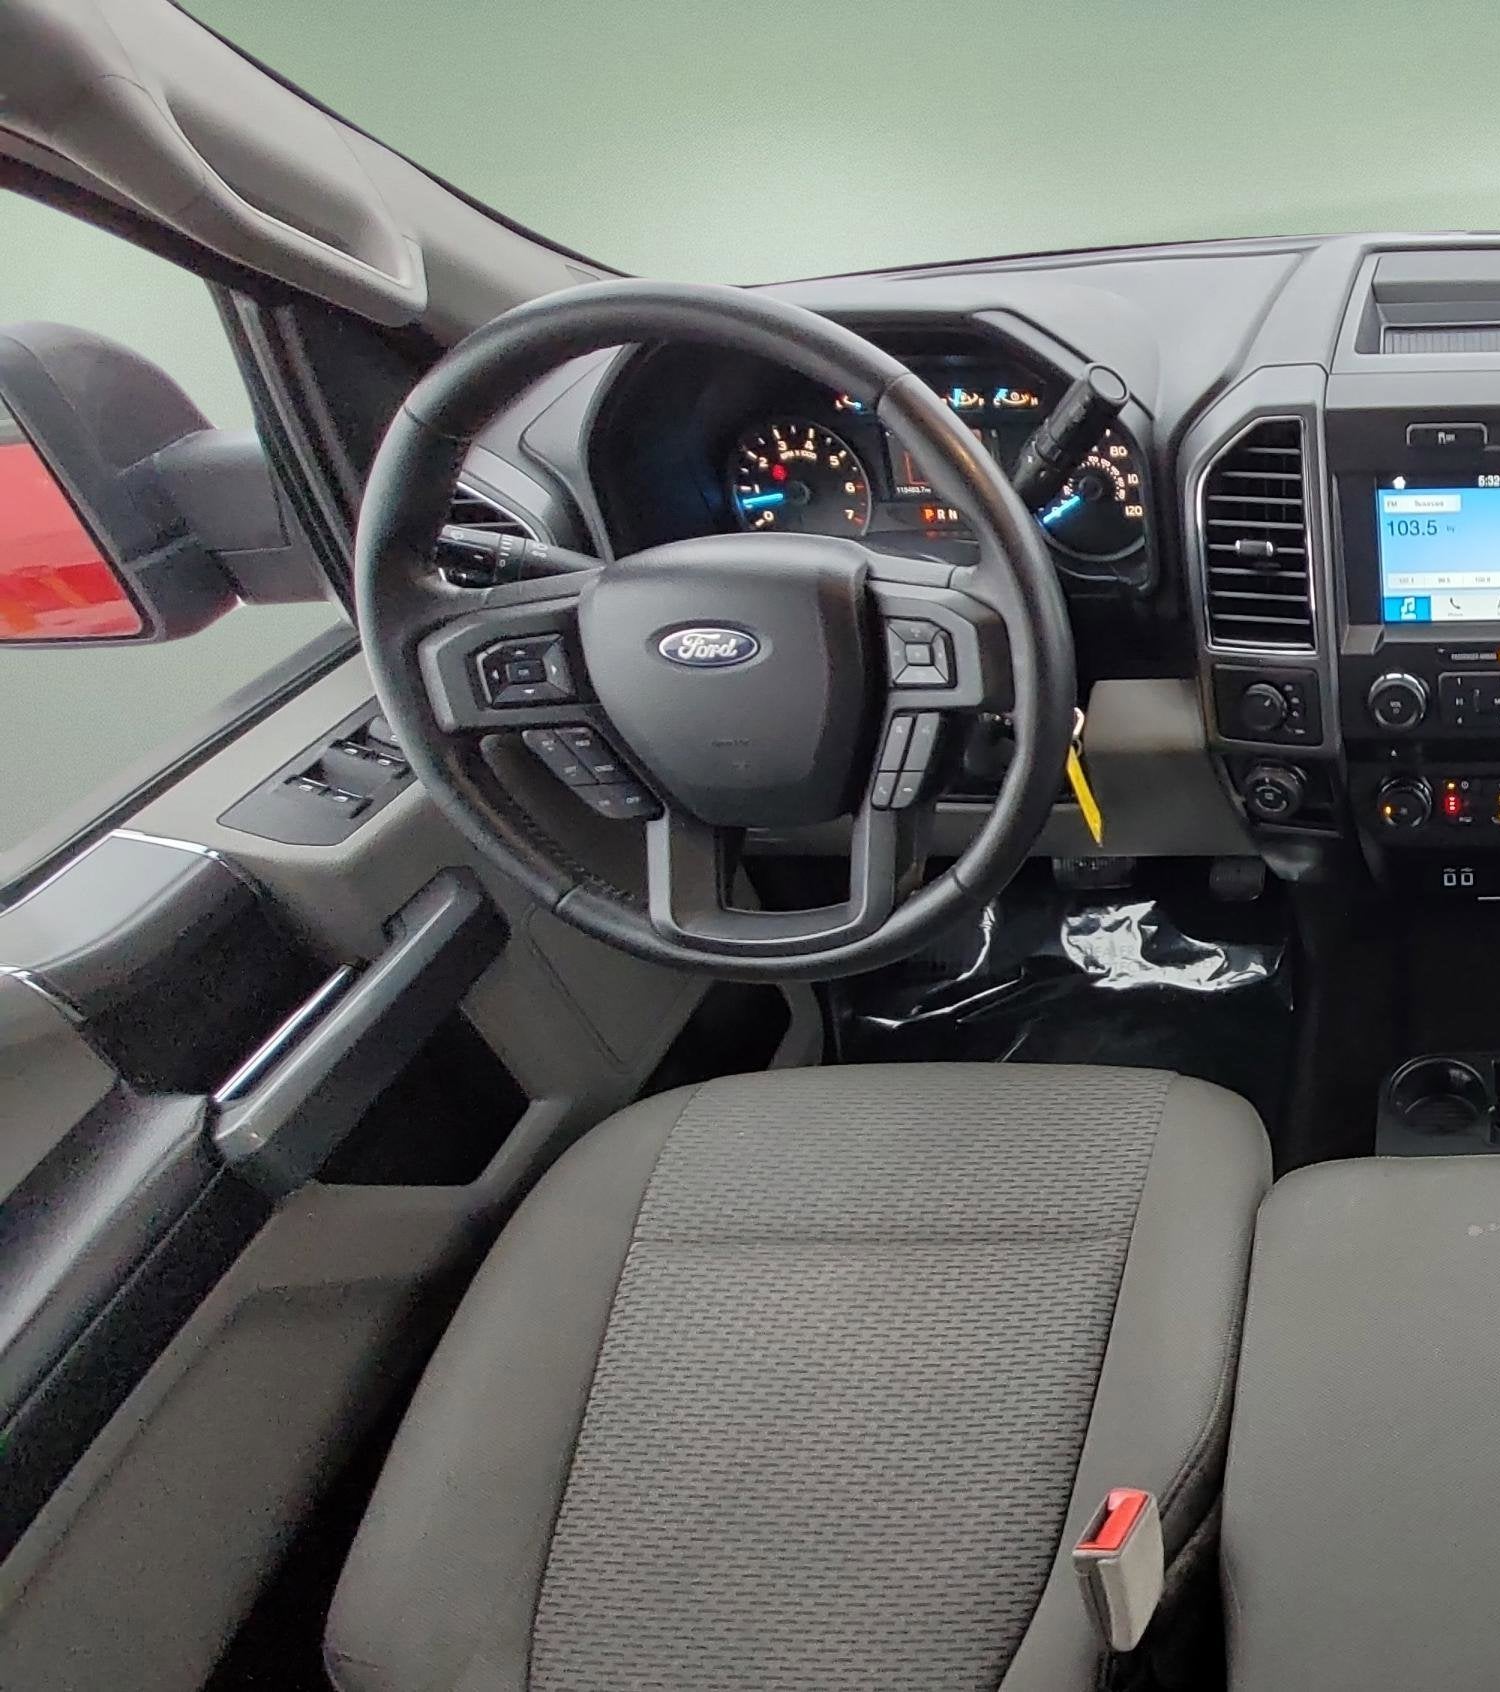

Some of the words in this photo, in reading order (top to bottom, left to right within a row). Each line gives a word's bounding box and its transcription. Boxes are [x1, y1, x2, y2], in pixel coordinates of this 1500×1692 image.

[778, 441, 787, 451] 3
[804, 440, 814, 450] 4
[1109, 446, 1128, 456] 80
[759, 457, 768, 467] 2
[829, 456, 840, 466] 5
[845, 482, 855, 492] 6
[844, 509, 854, 520] 7
[925, 510, 935, 519] P
[937, 510, 945, 520] R
[949, 510, 958, 520] N
[1125, 505, 1143, 516] 120
[763, 511, 774, 521] 0
[1387, 520, 1437, 536] 103.5
[678, 633, 738, 659] Ford
